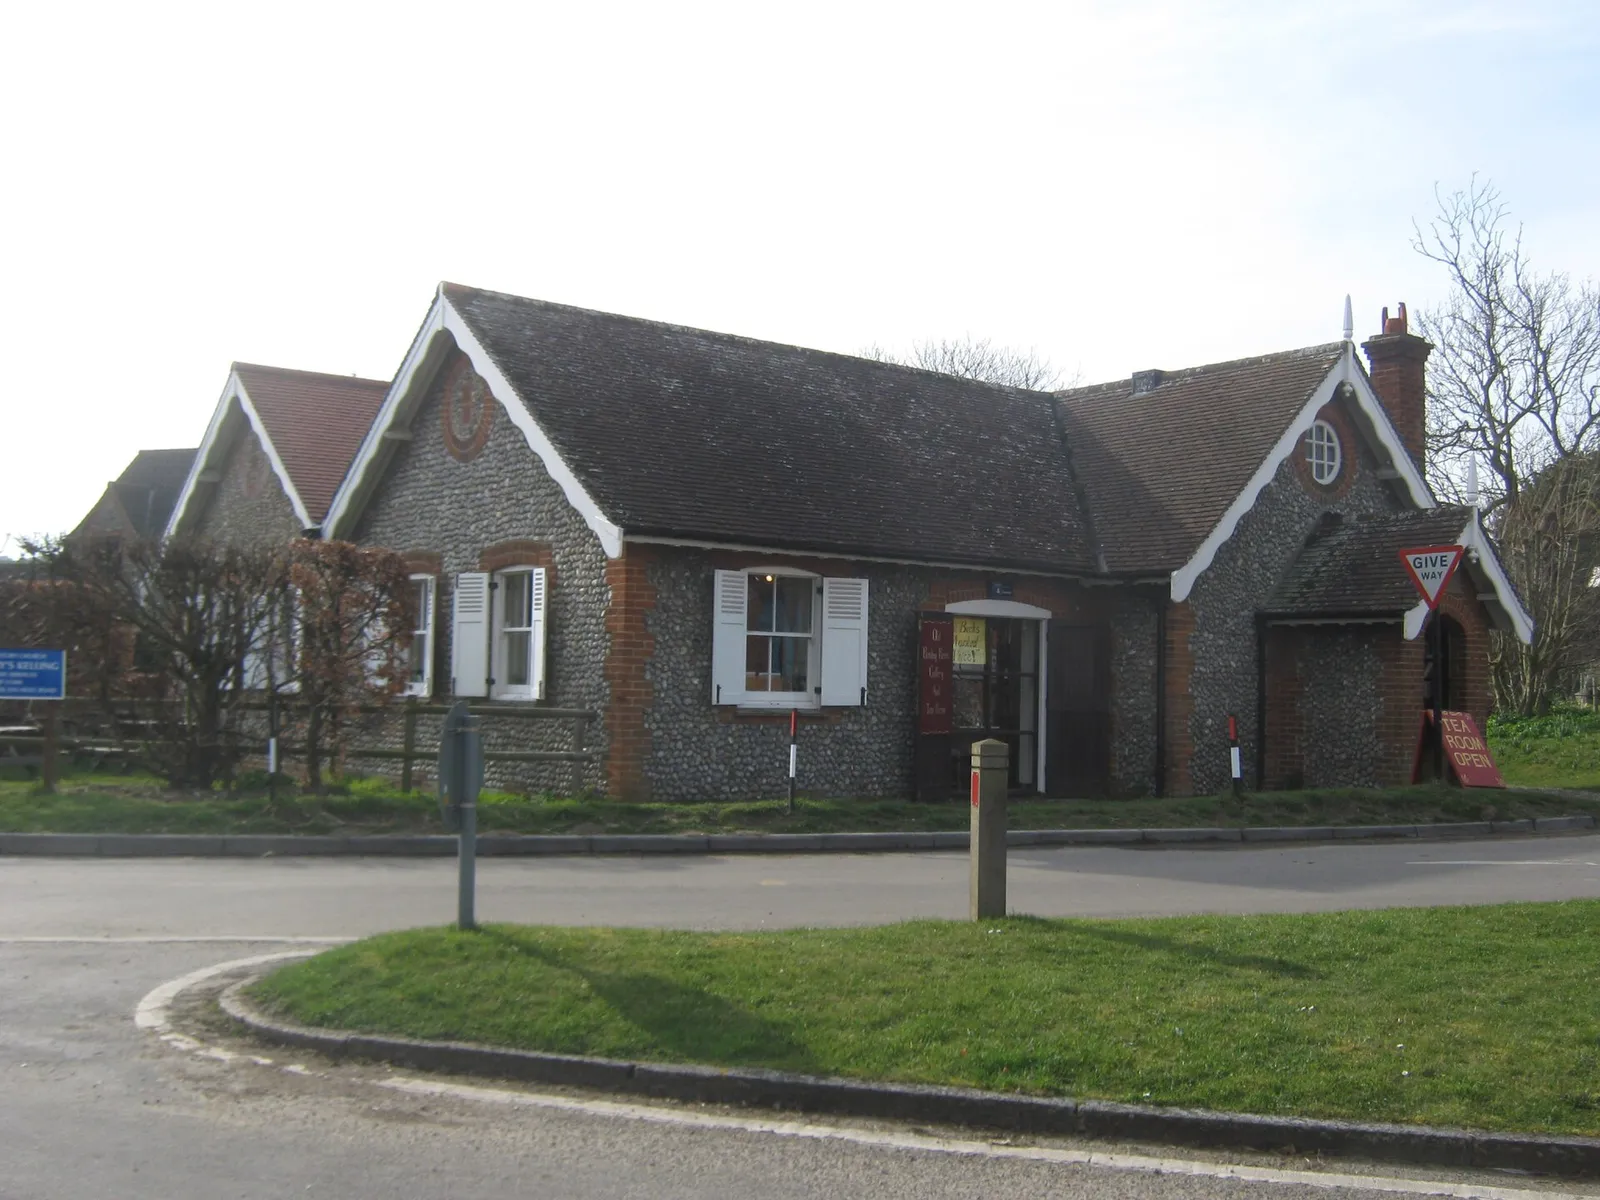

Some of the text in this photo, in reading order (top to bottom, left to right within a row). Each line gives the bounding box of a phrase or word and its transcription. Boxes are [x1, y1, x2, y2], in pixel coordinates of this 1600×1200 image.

[1412, 555, 1448, 569] GIVE
[1421, 571, 1444, 580] WAY
[1441, 718, 1471, 733] TEA
[1445, 735, 1486, 751] ROOM
[1454, 752, 1493, 768] OPEN
